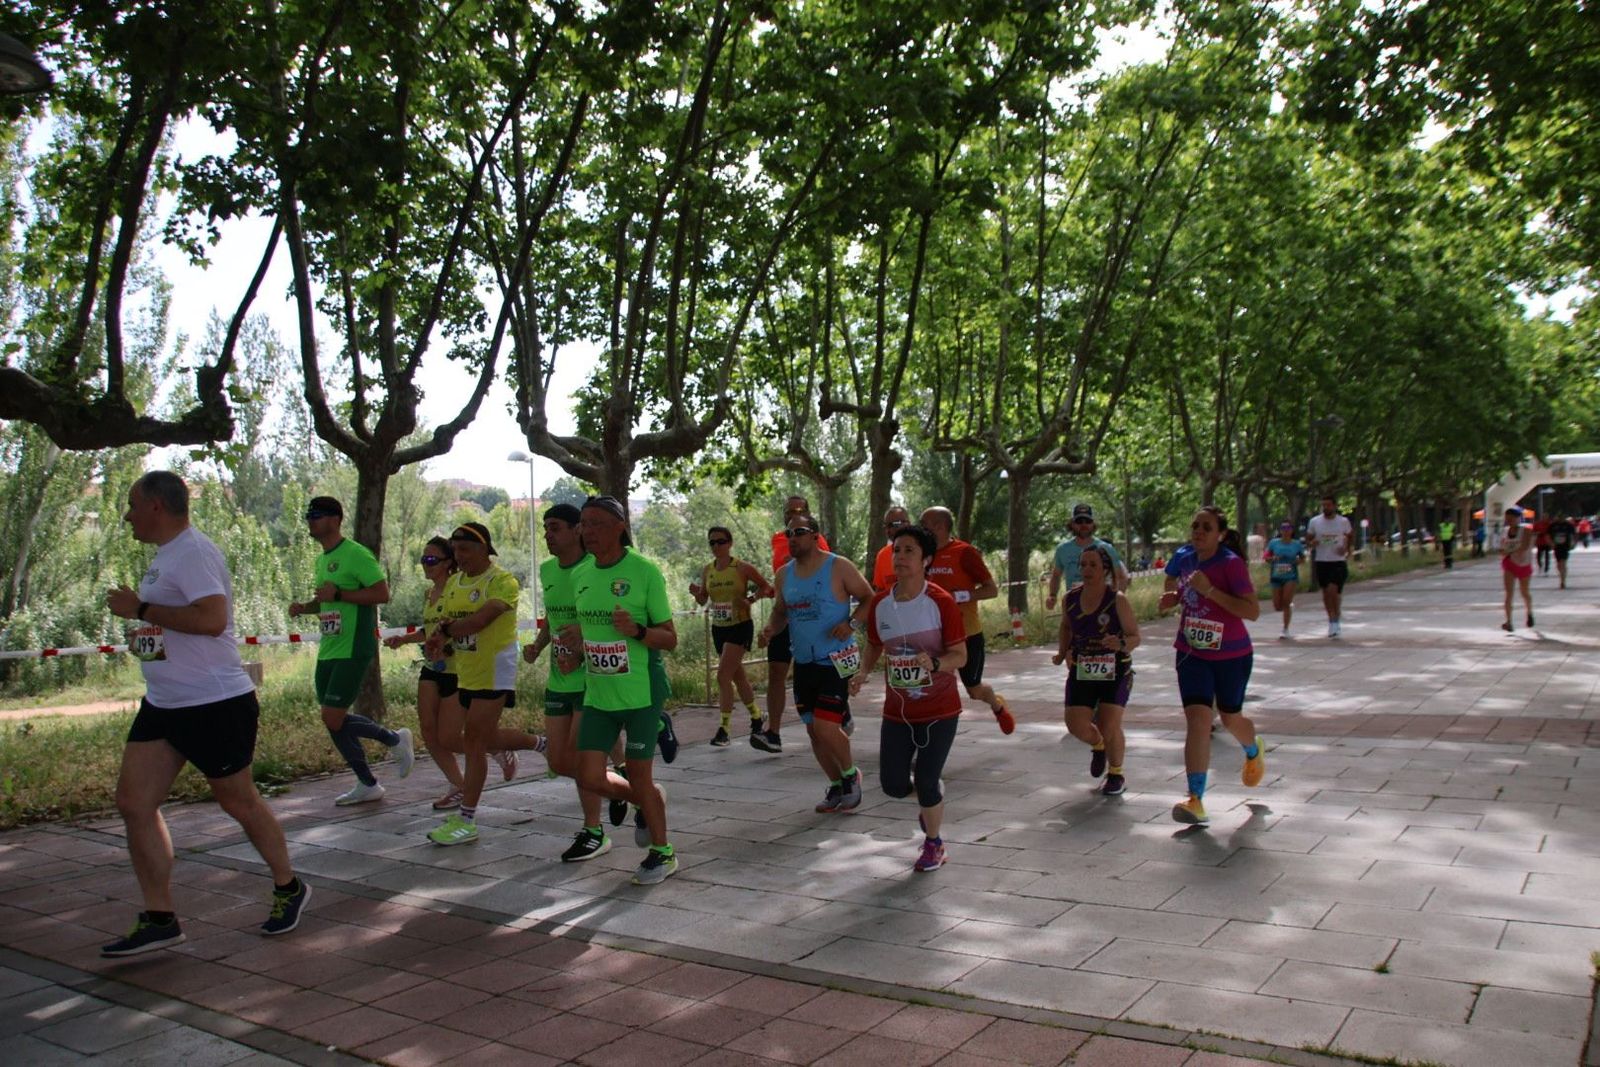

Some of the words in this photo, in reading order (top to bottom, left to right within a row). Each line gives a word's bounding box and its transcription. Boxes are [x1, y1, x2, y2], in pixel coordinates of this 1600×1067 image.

[1190, 629, 1214, 642] 308
[592, 654, 619, 668] 360
[894, 667, 920, 680] 307
[1085, 663, 1108, 674] 376
